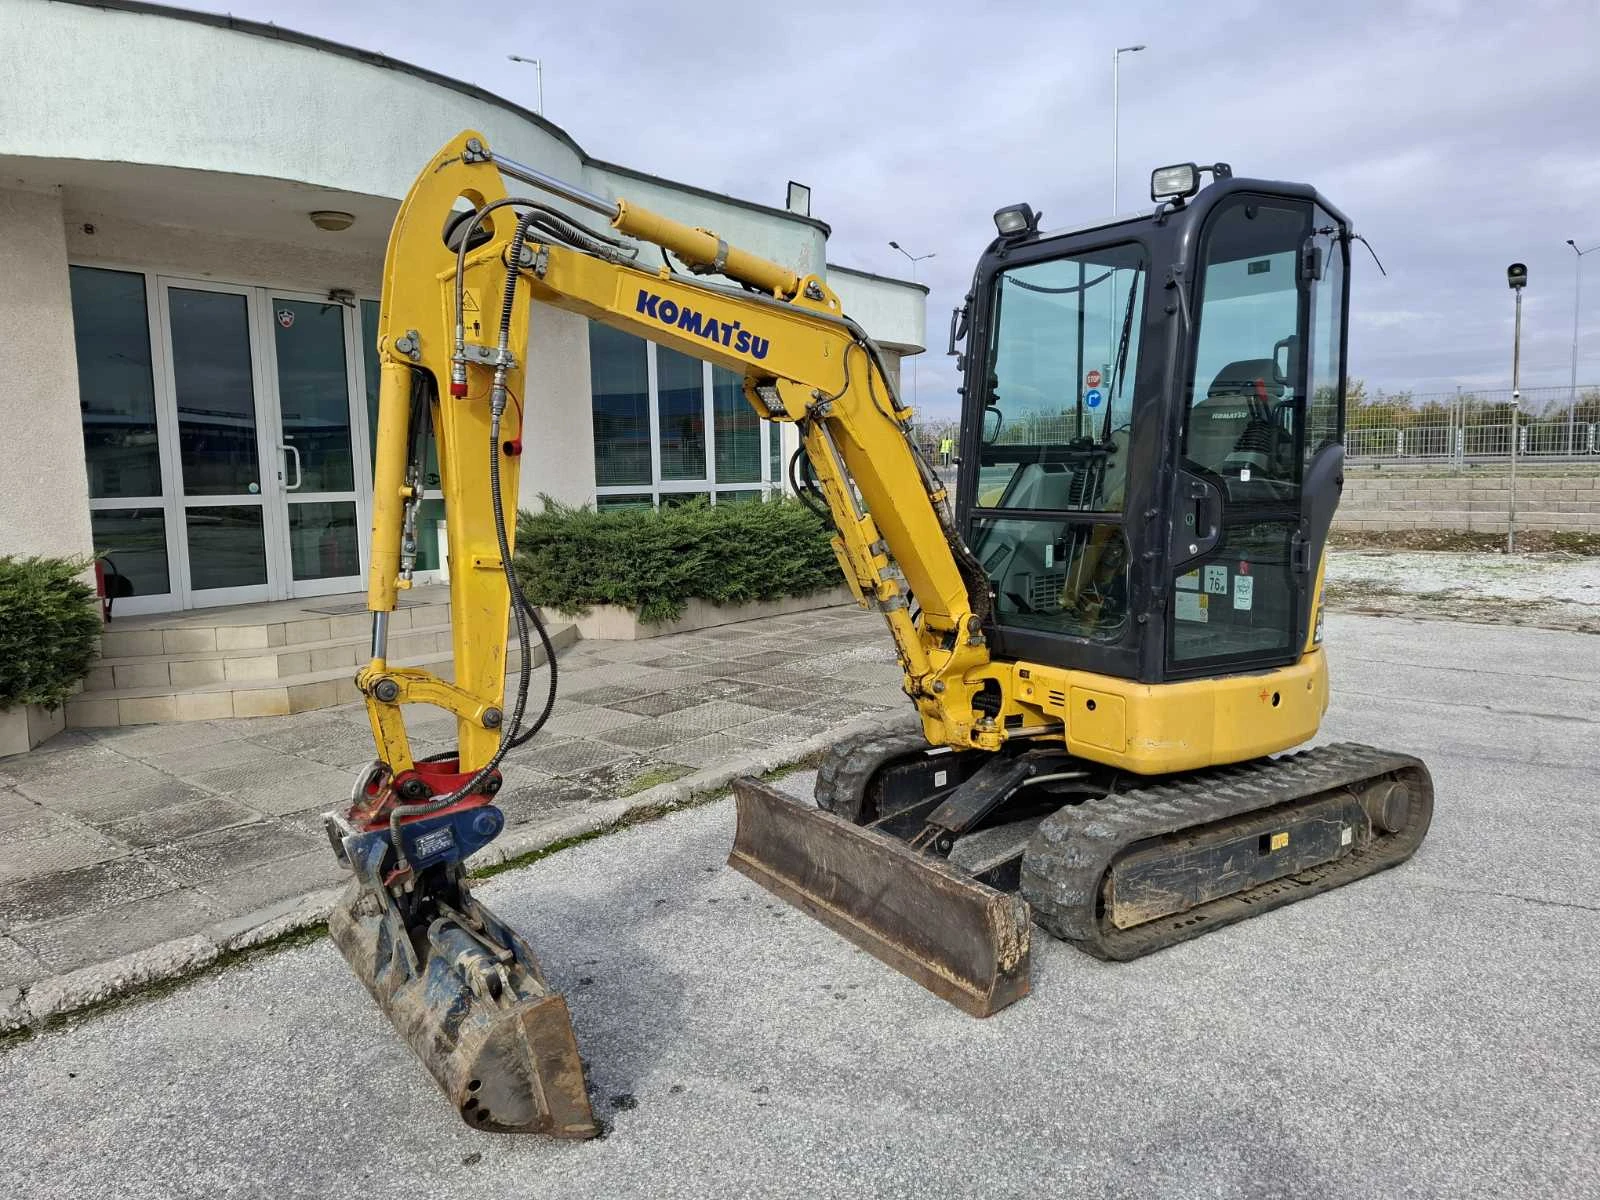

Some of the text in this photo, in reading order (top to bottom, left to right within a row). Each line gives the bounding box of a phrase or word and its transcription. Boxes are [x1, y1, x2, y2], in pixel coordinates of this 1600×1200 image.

[636, 289, 769, 360] KOMATSU
[1087, 375, 1100, 384] STOP
[1212, 411, 1248, 419] KOMATSU
[1209, 577, 1220, 591] 76
